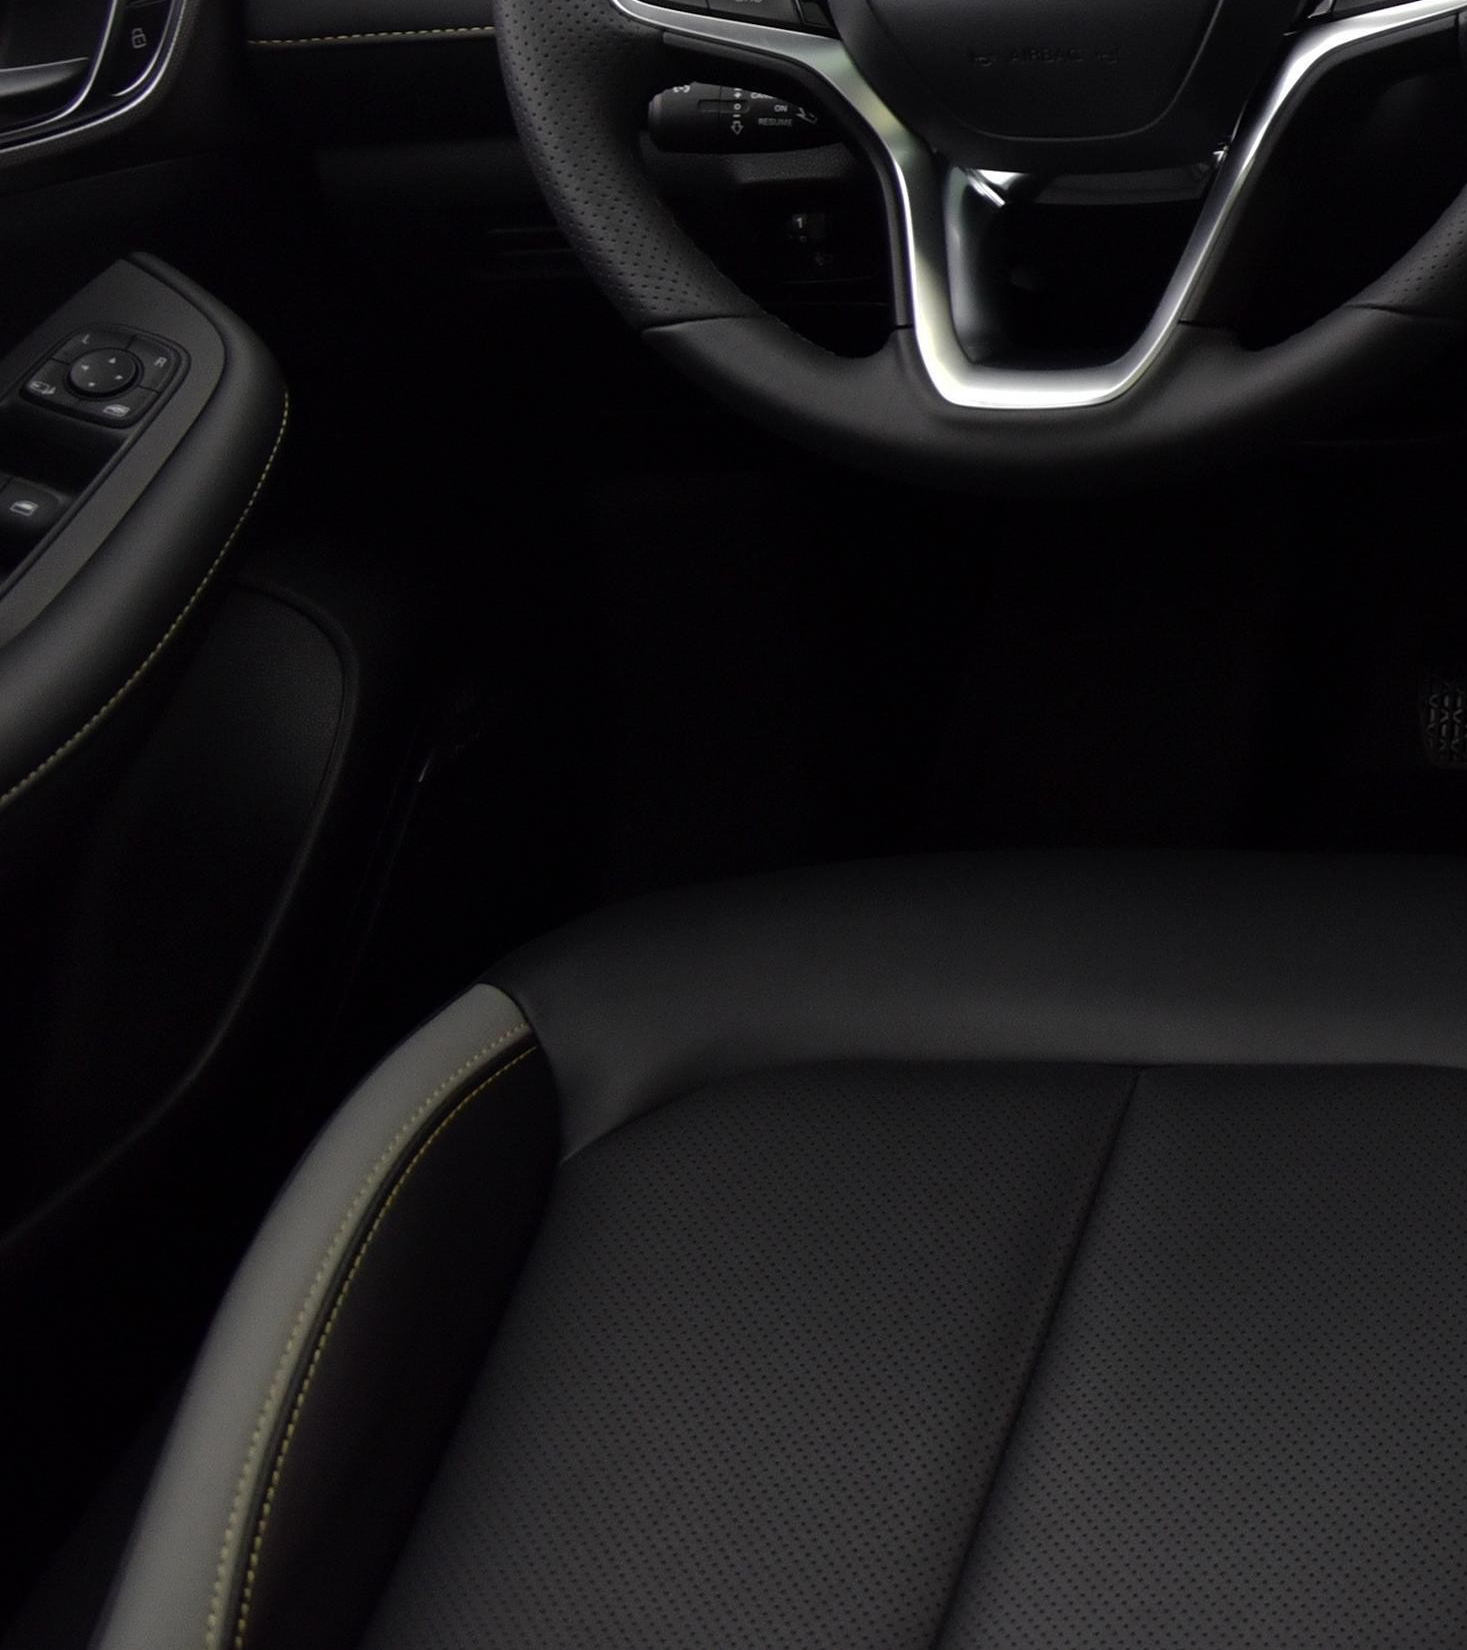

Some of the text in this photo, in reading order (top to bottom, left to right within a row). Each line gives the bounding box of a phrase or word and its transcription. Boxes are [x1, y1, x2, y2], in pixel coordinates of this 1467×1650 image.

[774, 104, 788, 113] ON
[757, 117, 793, 127] RESUME
[82, 333, 90, 344] L
[154, 356, 167, 368] R
